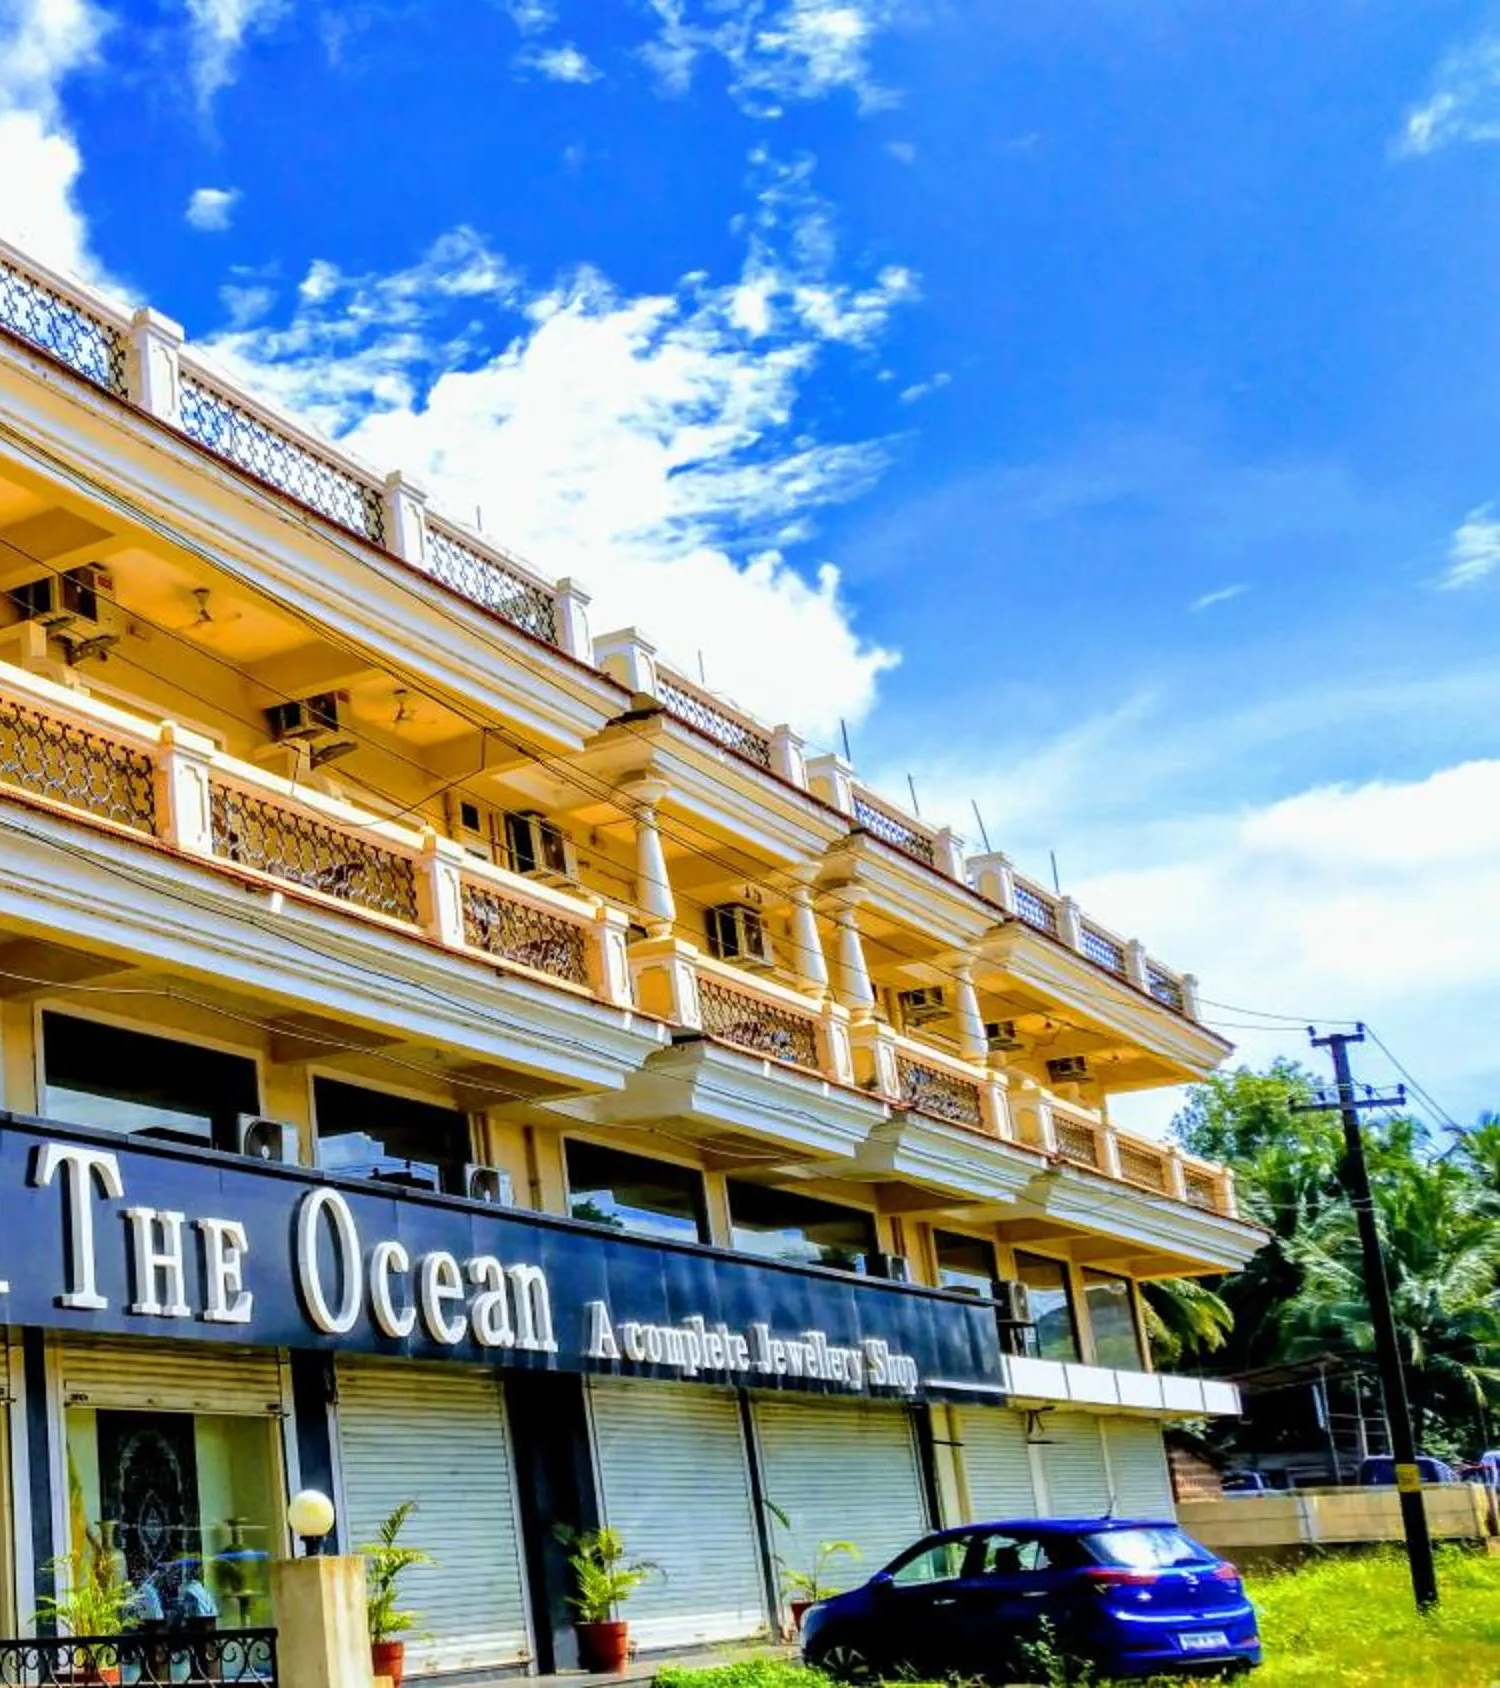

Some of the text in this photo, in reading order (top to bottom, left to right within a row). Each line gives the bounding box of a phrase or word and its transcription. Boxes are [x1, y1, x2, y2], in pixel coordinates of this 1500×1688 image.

[34, 1142, 559, 1353] THE Ocean
[581, 1300, 918, 1395] A complete Jewellery Shop
